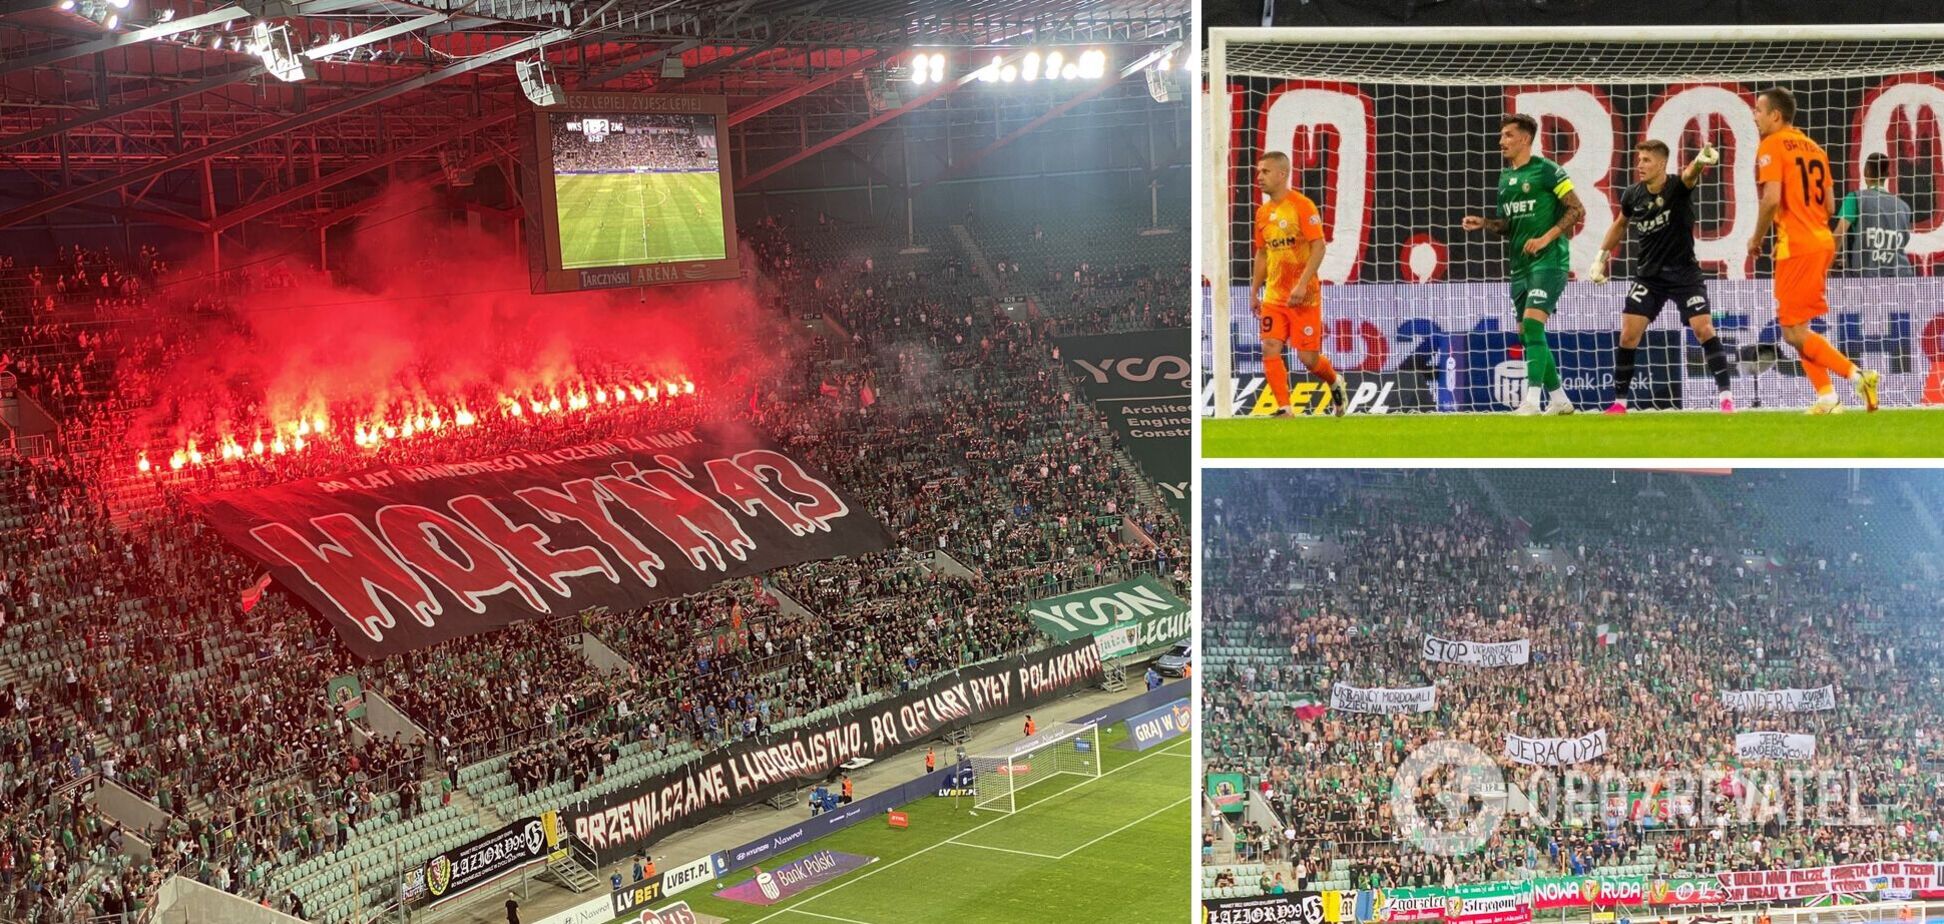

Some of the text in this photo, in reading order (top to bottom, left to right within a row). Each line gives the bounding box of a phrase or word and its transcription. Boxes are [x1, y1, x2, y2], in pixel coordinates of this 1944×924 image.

[1795, 156, 1825, 207] 13
[1872, 250, 1895, 264] 047
[581, 265, 679, 288] TARCZYŃSKI ARENA
[1072, 355, 1191, 384] YCO
[1562, 371, 1653, 391] ank Pski
[350, 470, 395, 490] LAT
[617, 436, 650, 451] ZA
[1028, 585, 1174, 632] YCON
[1425, 638, 1467, 661] STOP
[1482, 655, 1513, 666] POLSKI
[1339, 700, 1368, 711] DZIECI
[1372, 704, 1382, 713] NA
[1382, 690, 1430, 704] MORDOWALI
[1725, 690, 1798, 713] BANDERA
[1135, 719, 1163, 742] GRAJ
[1160, 714, 1173, 731] W
[1573, 733, 1604, 761] UPA
[575, 763, 730, 849] PRZEMILCZANE
[872, 712, 896, 755] BO
[901, 685, 973, 738] OFIARY
[970, 671, 1011, 713] BYŁY
[774, 828, 803, 849] Nawrot
[666, 861, 710, 890] LVBET.PL
[777, 850, 836, 887] Bank Polski
[617, 882, 660, 912] LVBET
[1535, 881, 1580, 900] NOWA
[1601, 879, 1641, 899] RUDA
[1464, 899, 1514, 912] Strzegom
